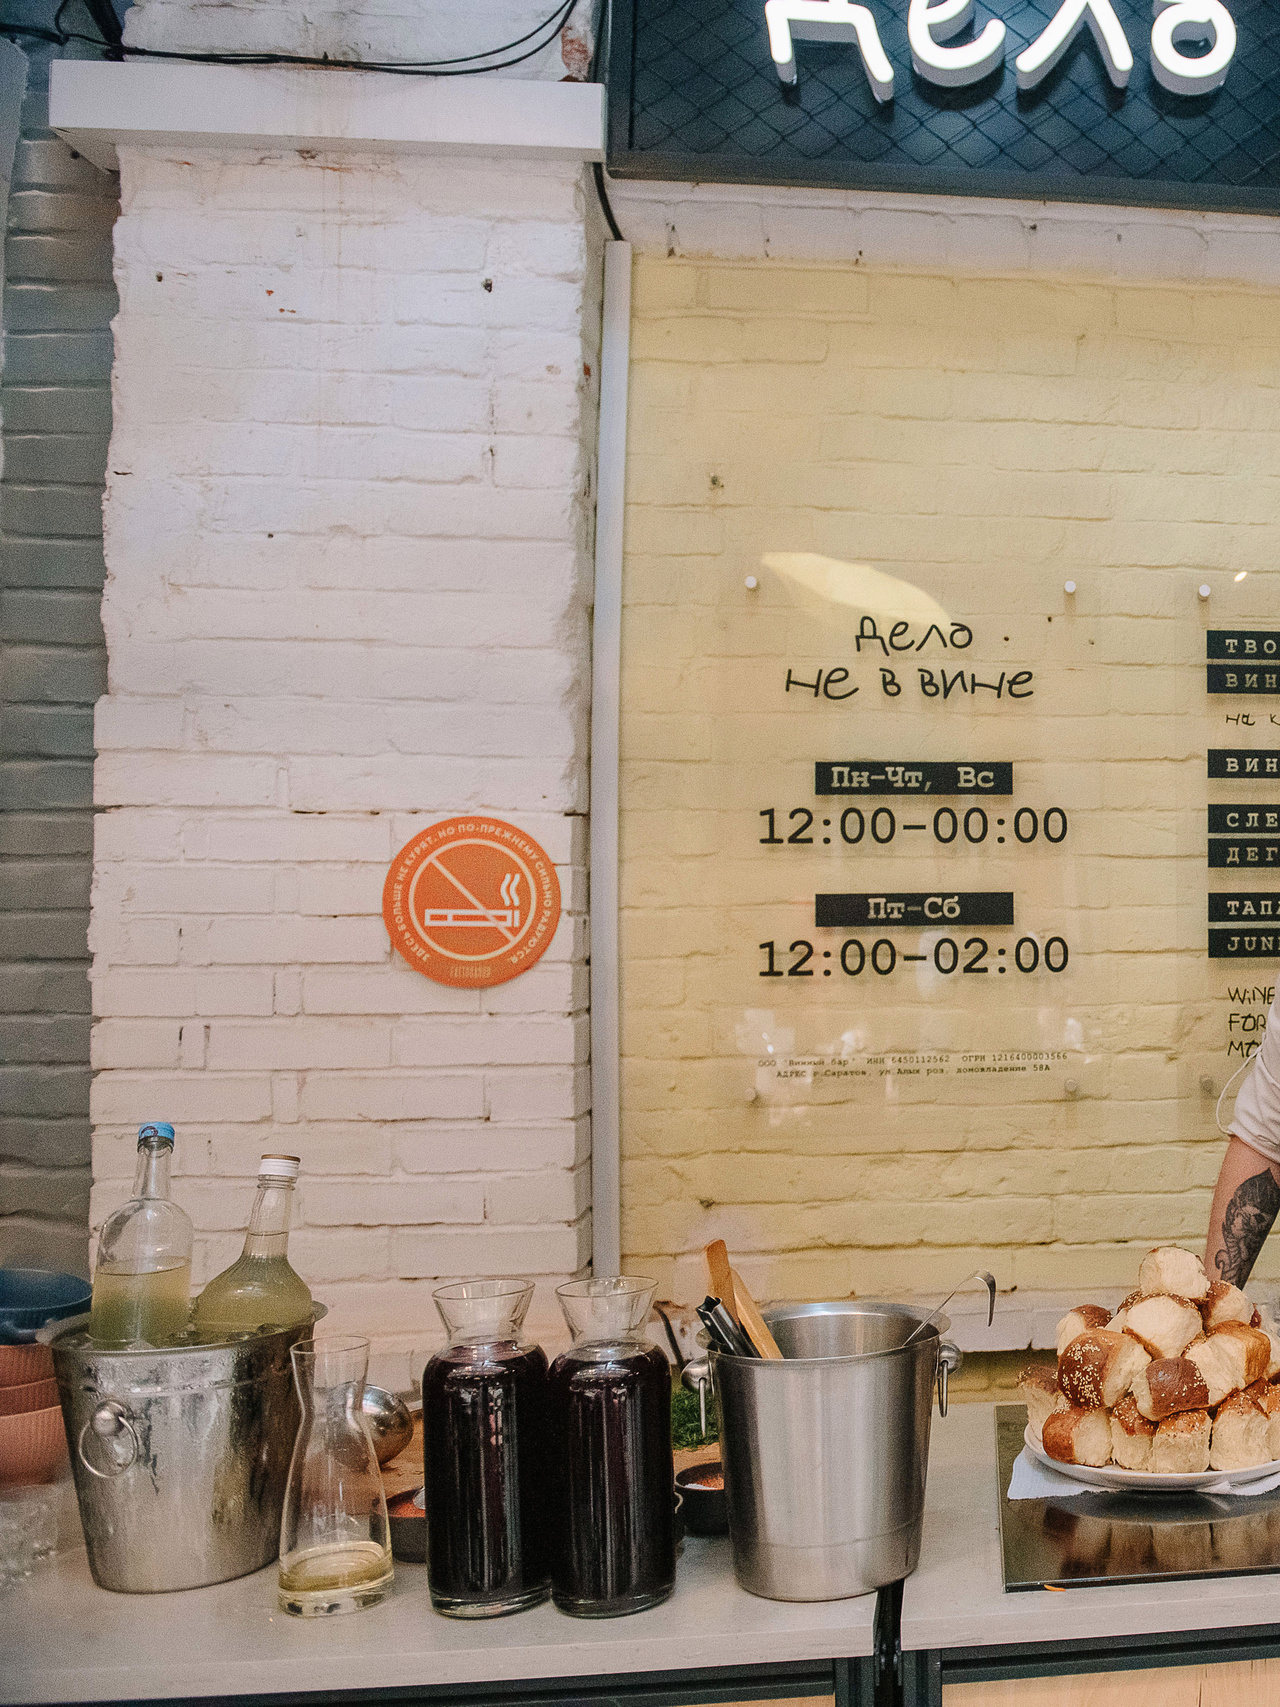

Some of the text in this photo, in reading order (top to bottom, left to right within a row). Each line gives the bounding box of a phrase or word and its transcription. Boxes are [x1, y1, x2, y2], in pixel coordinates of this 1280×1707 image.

[879, 667, 901, 697] в
[917, 667, 1034, 699] вине
[956, 766, 995, 788] Вс
[437, 826, 455, 839] НО
[396, 867, 409, 882] НЕ
[535, 861, 552, 907] СИЛЬНО
[393, 883, 407, 931] БОЛЬШЕ
[866, 1056, 885, 1065] ИНН
[961, 1054, 986, 1062] ОГРН
[992, 1052, 1068, 1062] 1216400003566
